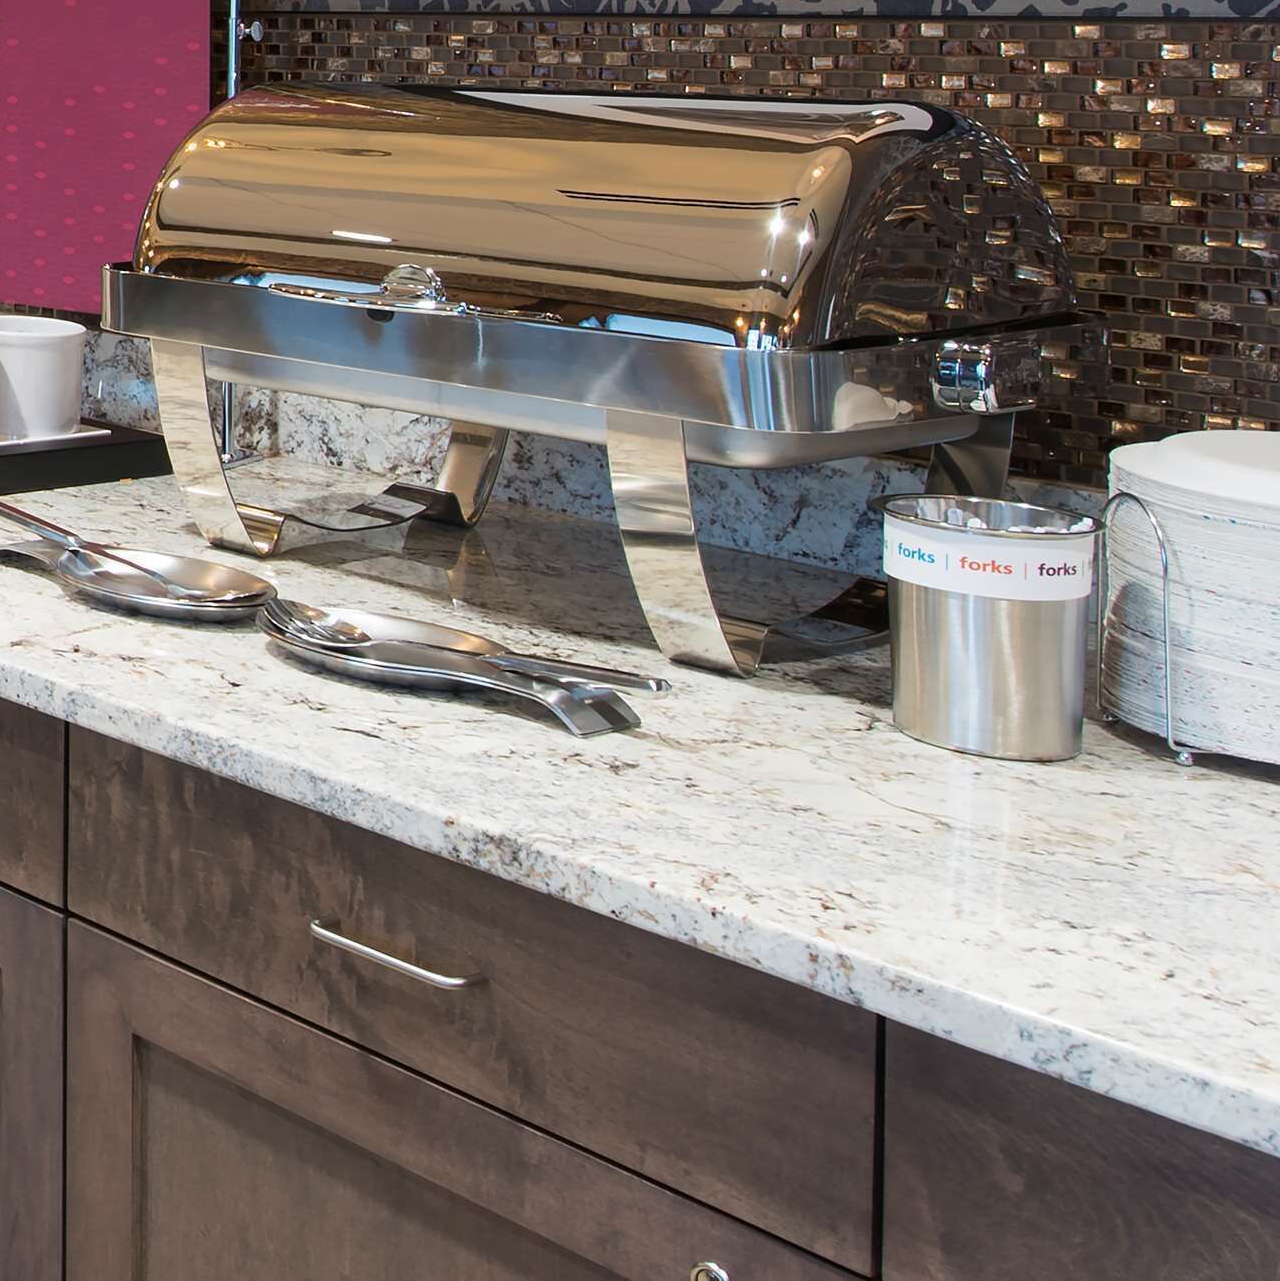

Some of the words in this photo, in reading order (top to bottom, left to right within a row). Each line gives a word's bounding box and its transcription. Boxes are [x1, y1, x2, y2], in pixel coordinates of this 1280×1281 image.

[898, 542, 936, 564] forks
[959, 556, 1014, 575] forks
[1037, 563, 1077, 577] forks
